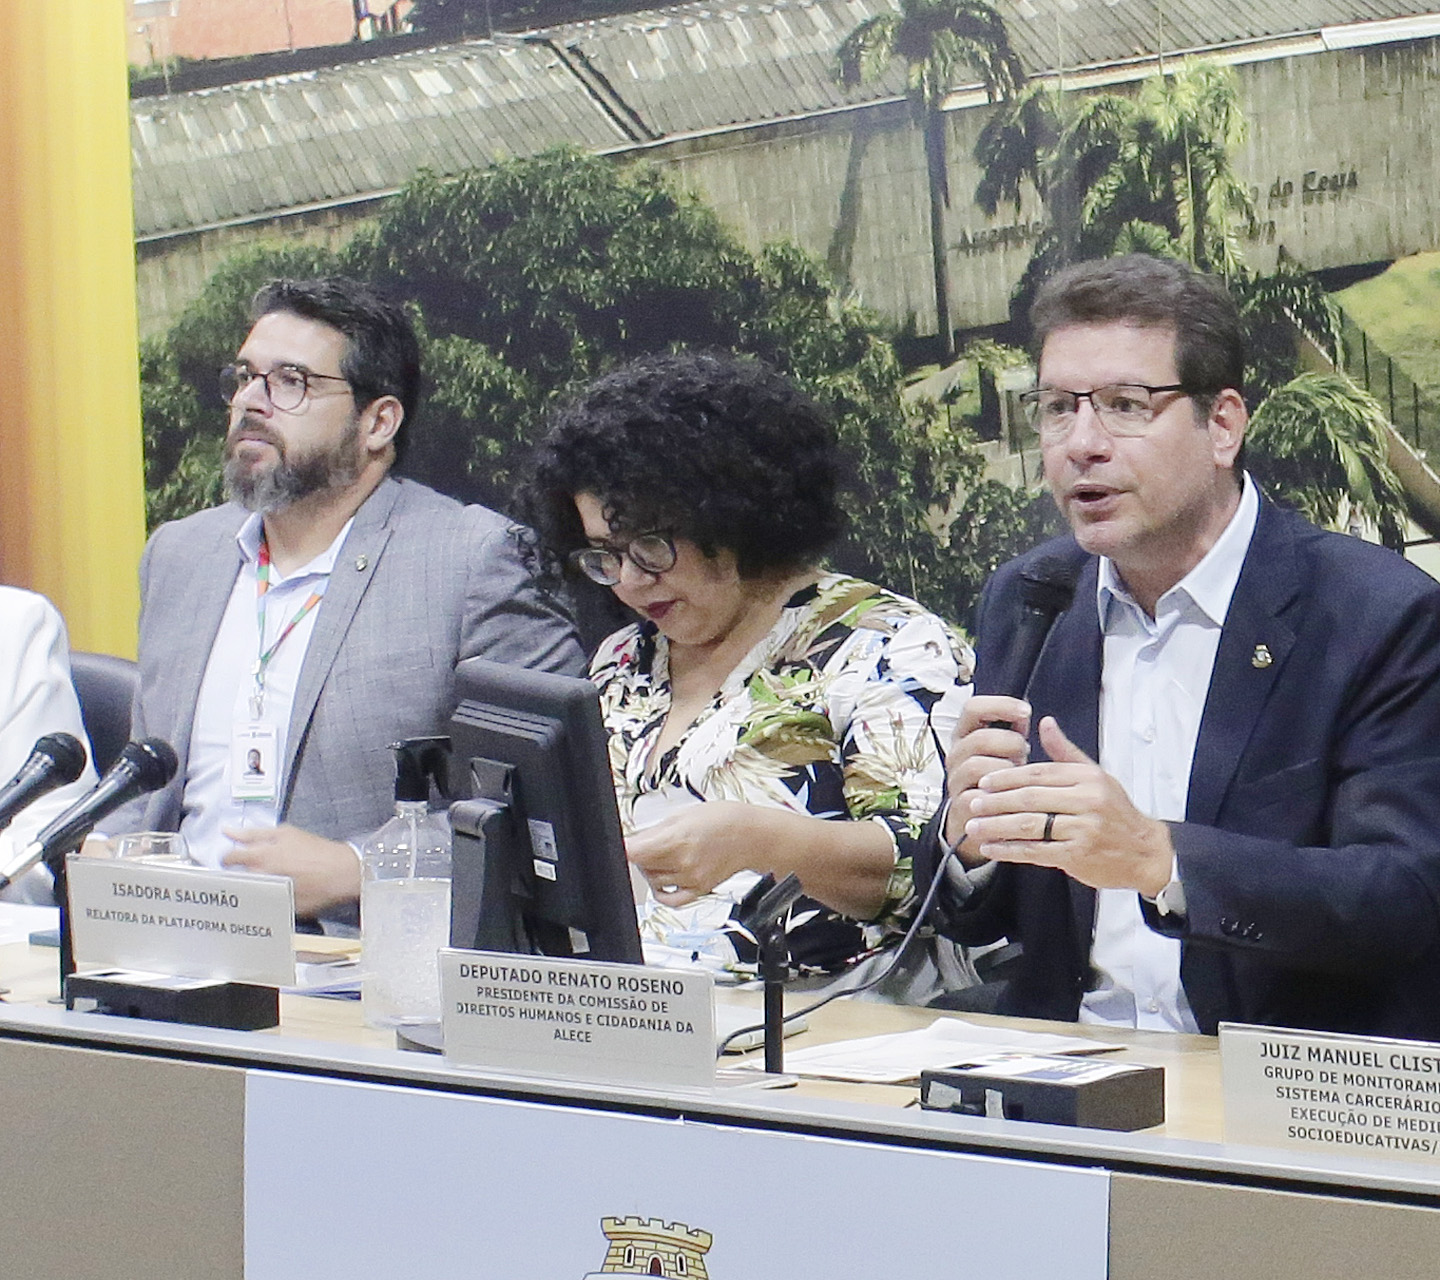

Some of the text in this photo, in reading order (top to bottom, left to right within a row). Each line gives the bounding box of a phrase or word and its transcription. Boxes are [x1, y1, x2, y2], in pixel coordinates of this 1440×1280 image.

[112, 883, 239, 908] ISADORA SALOMÃO
[86, 908, 272, 938] RELATORA DA PLATAFORMA DHESCA
[460, 964, 684, 995] DEPUTADO RENATO ROSENO
[477, 986, 669, 1013] PRESIDENTE DA COMISSÃO DE
[457, 1002, 694, 1034] DIREITOS HUMANOS E CIDADANIA DA
[553, 1029, 592, 1043] ALECE
[1260, 1042, 1302, 1060] JUIZ
[1307, 1046, 1384, 1068] MANUEL
[1264, 1065, 1314, 1082] GRUPO
[1319, 1070, 1338, 1084] DE
[1276, 1086, 1341, 1104] SISTEMA
[1291, 1106, 1368, 1127] EXECUÇÃO
[1373, 1115, 1392, 1129] DE
